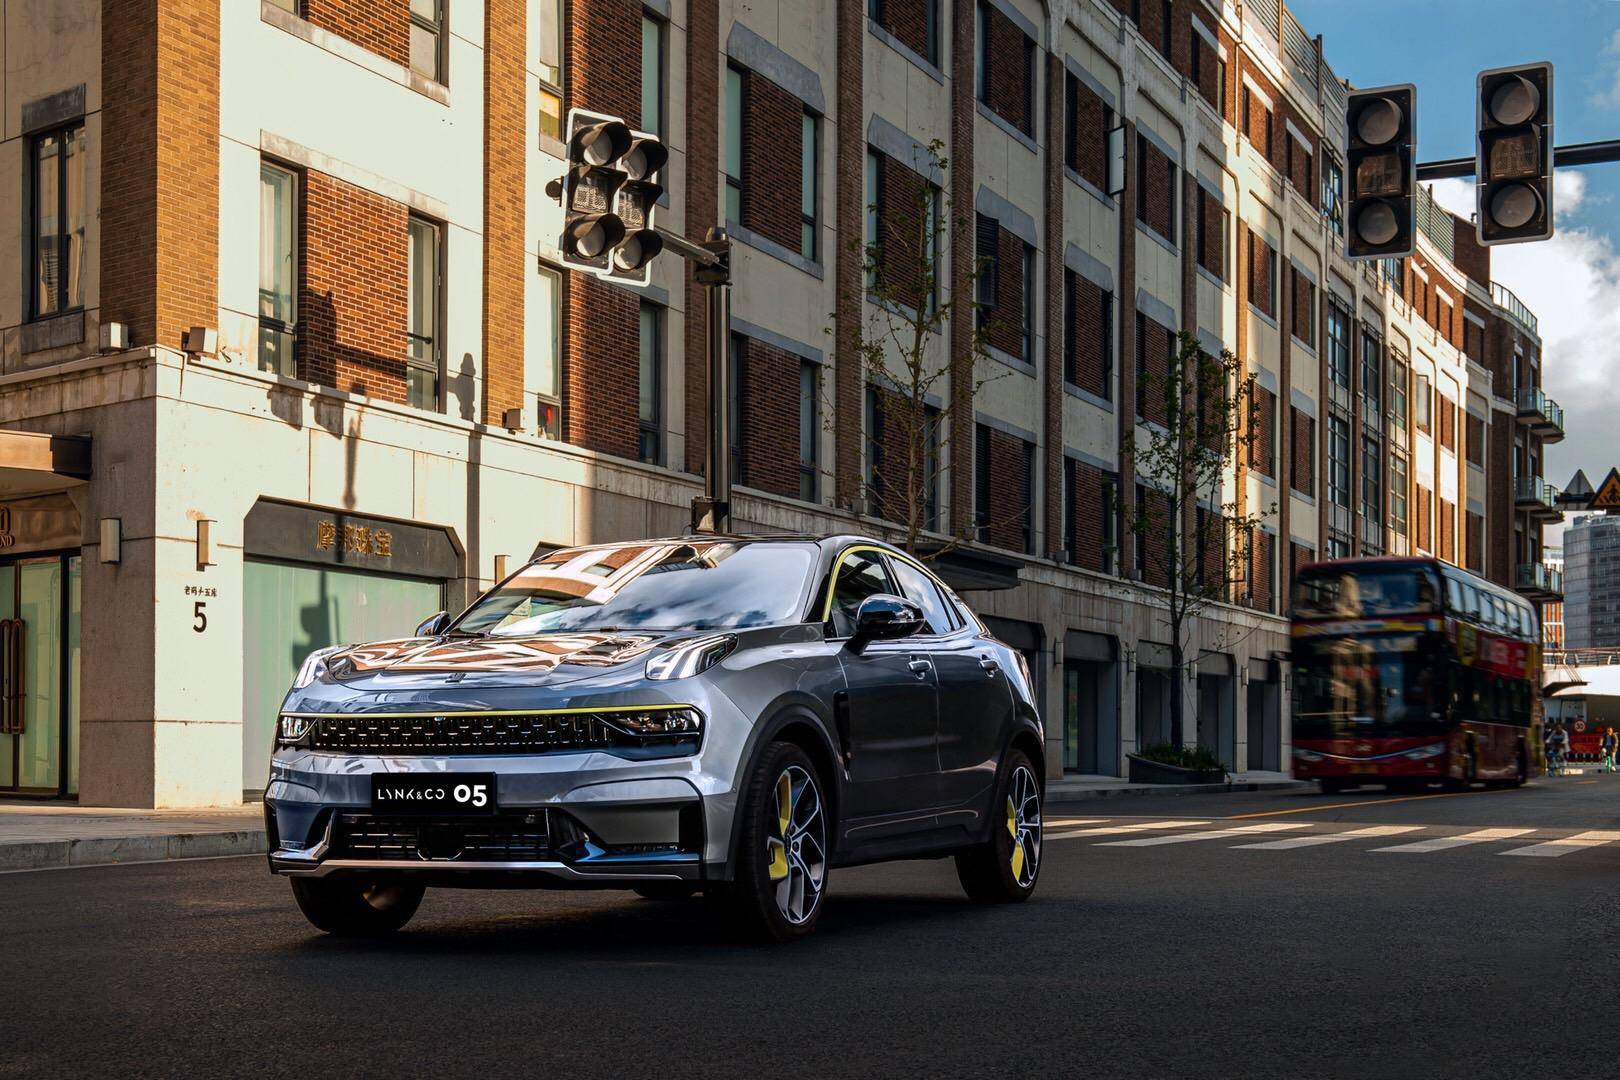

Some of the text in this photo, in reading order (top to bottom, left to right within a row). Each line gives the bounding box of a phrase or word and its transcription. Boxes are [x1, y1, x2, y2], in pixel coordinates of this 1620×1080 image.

[193, 601, 207, 633] 5
[377, 784, 487, 807] LYNK&CO 05
